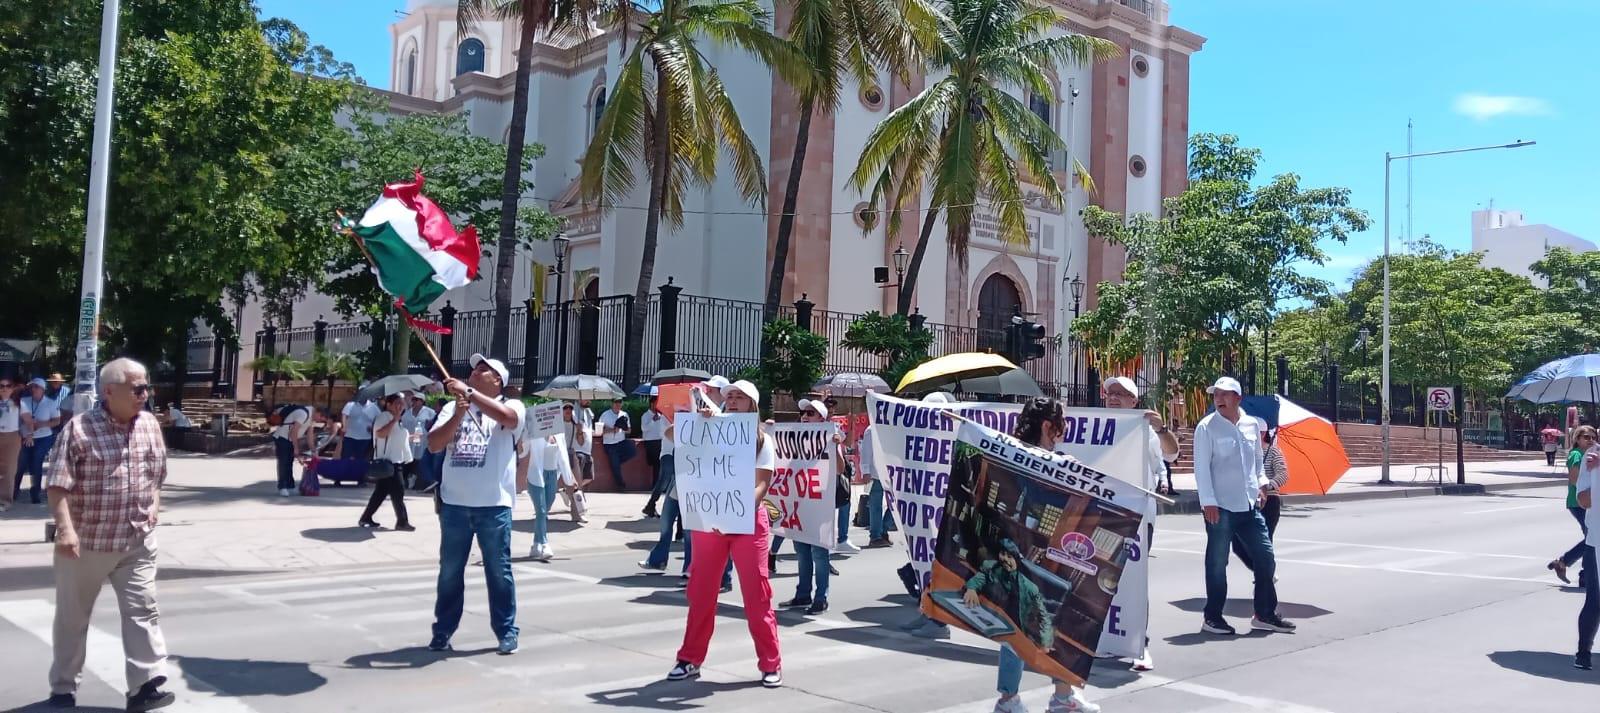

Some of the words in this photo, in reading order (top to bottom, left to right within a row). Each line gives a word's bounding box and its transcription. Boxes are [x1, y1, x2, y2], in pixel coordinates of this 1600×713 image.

[80, 298, 96, 341] GREEN
[679, 420, 750, 447] CLAXON
[875, 400, 890, 425] EL
[892, 402, 954, 432] PODER
[1063, 416, 1088, 445] DE
[1091, 417, 1116, 446] LA
[775, 430, 830, 460] JUDICIAL
[686, 455, 702, 478] SI
[713, 454, 737, 480] ME
[979, 438, 1009, 458] DEL
[1013, 452, 1117, 501] BIENESTAR
[1058, 459, 1108, 484] JUEZ
[768, 468, 793, 497] ES
[795, 468, 823, 499] DE
[685, 490, 745, 518] APOYAS
[780, 500, 803, 531] LA
